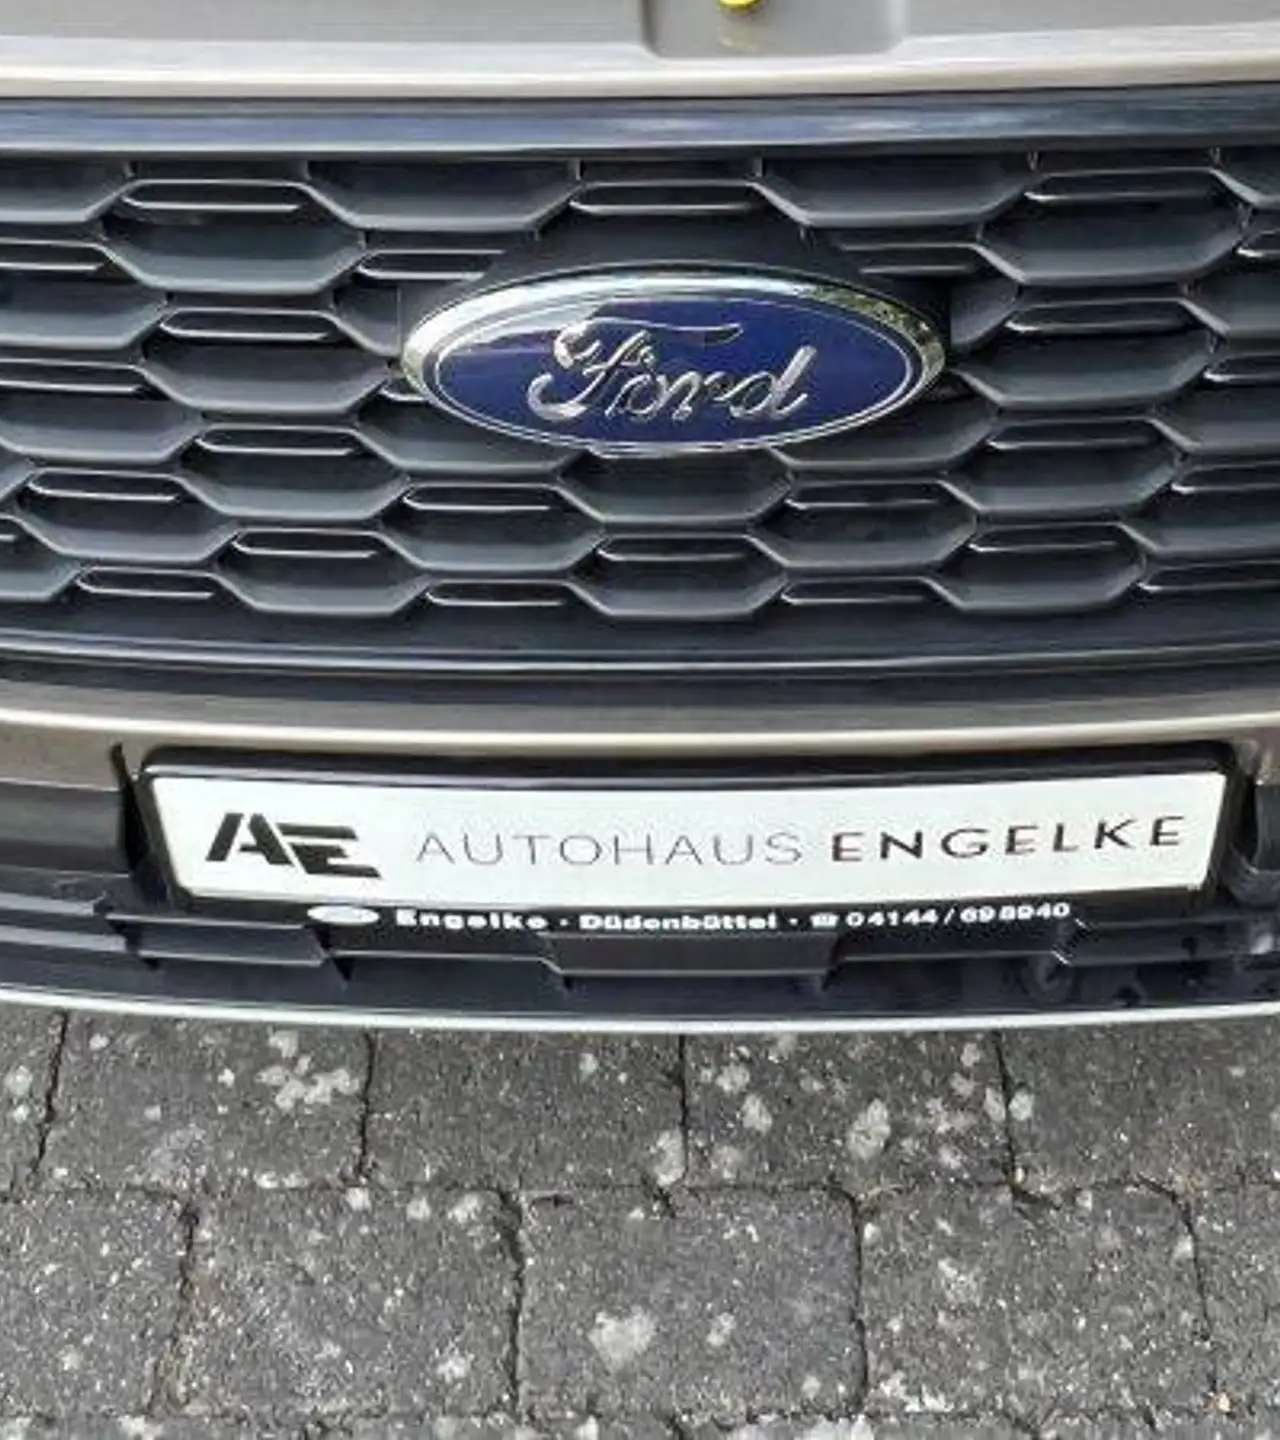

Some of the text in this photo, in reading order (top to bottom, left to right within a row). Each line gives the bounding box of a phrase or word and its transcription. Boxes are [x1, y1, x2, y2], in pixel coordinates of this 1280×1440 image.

[528, 316, 817, 423] Ford
[417, 815, 1186, 866] AUTOHAUS ENGELKE
[395, 908, 549, 931] Engelke
[579, 911, 778, 931] Düdenbüttel
